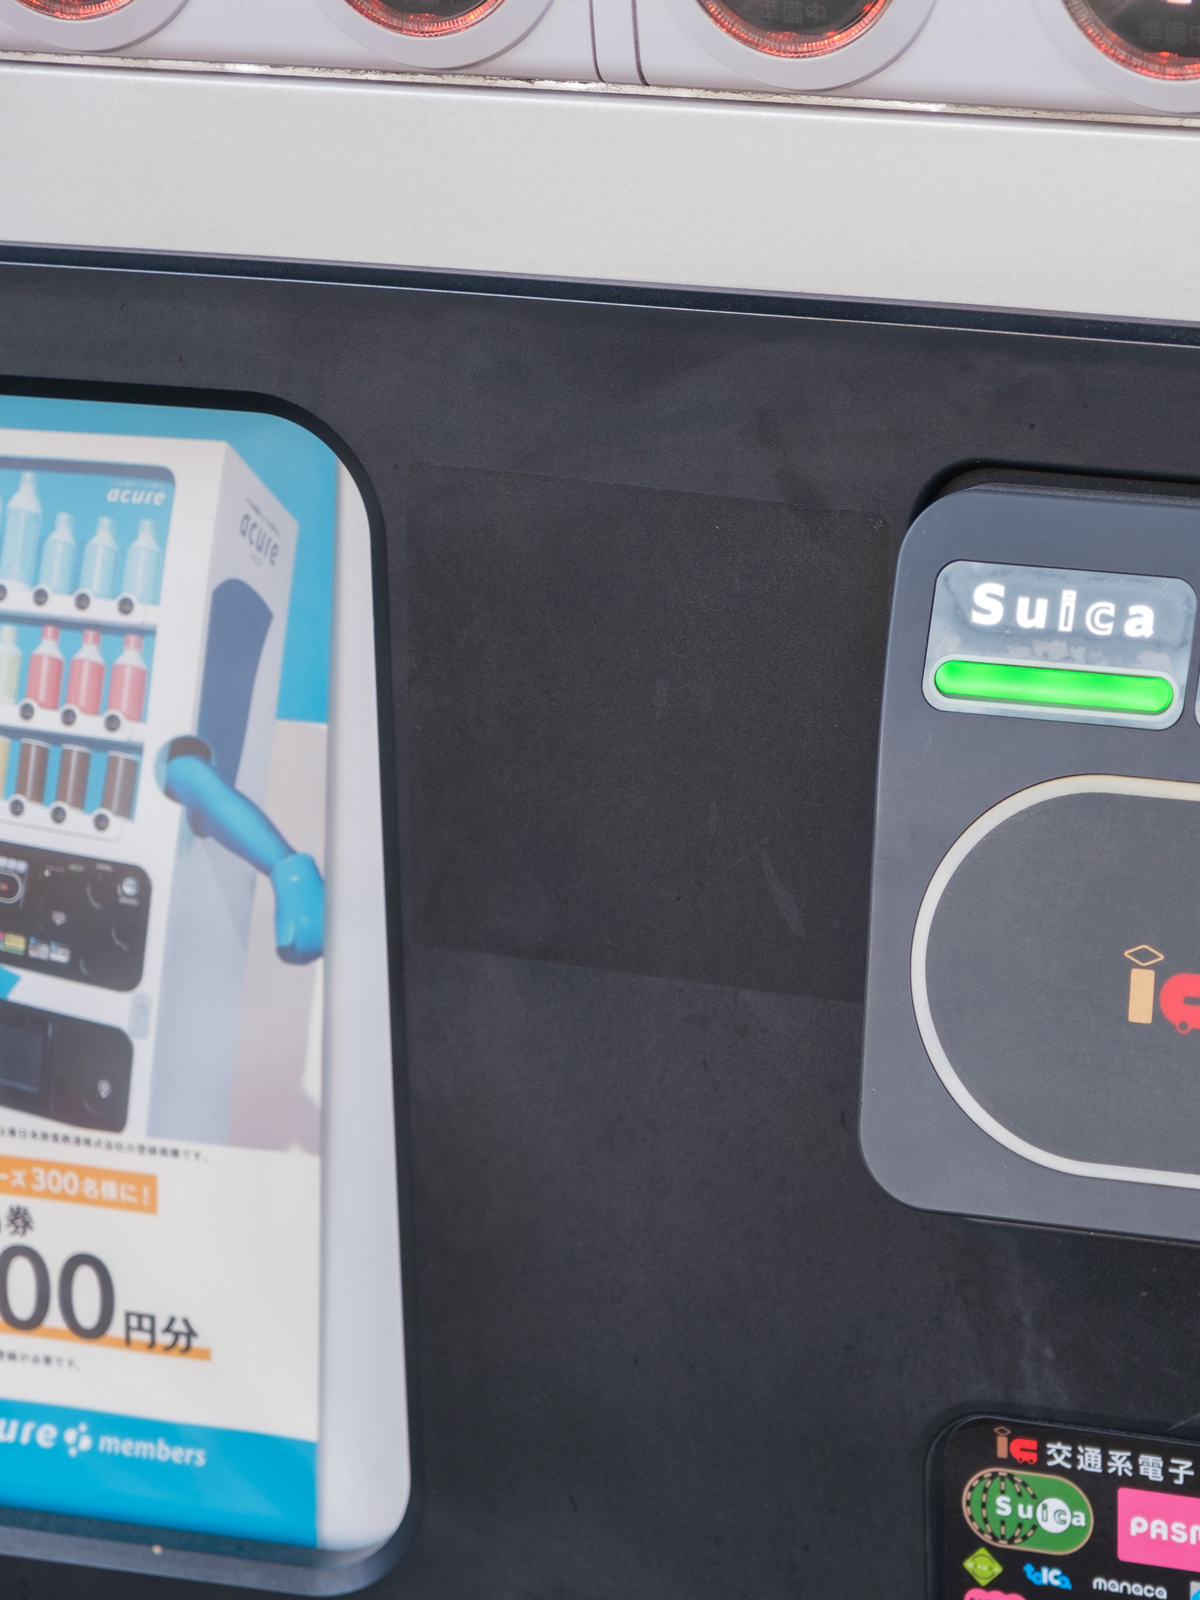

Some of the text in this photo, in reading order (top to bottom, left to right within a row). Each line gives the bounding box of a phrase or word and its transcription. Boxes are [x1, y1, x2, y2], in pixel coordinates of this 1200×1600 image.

[106, 487, 166, 506] acure
[239, 512, 280, 566] acure
[971, 582, 1156, 639] Suica
[0, 1205, 34, 1237] 券
[98, 1434, 206, 1467] members
[995, 1495, 1087, 1527] Suica
[1092, 1576, 1168, 1600] manaca
